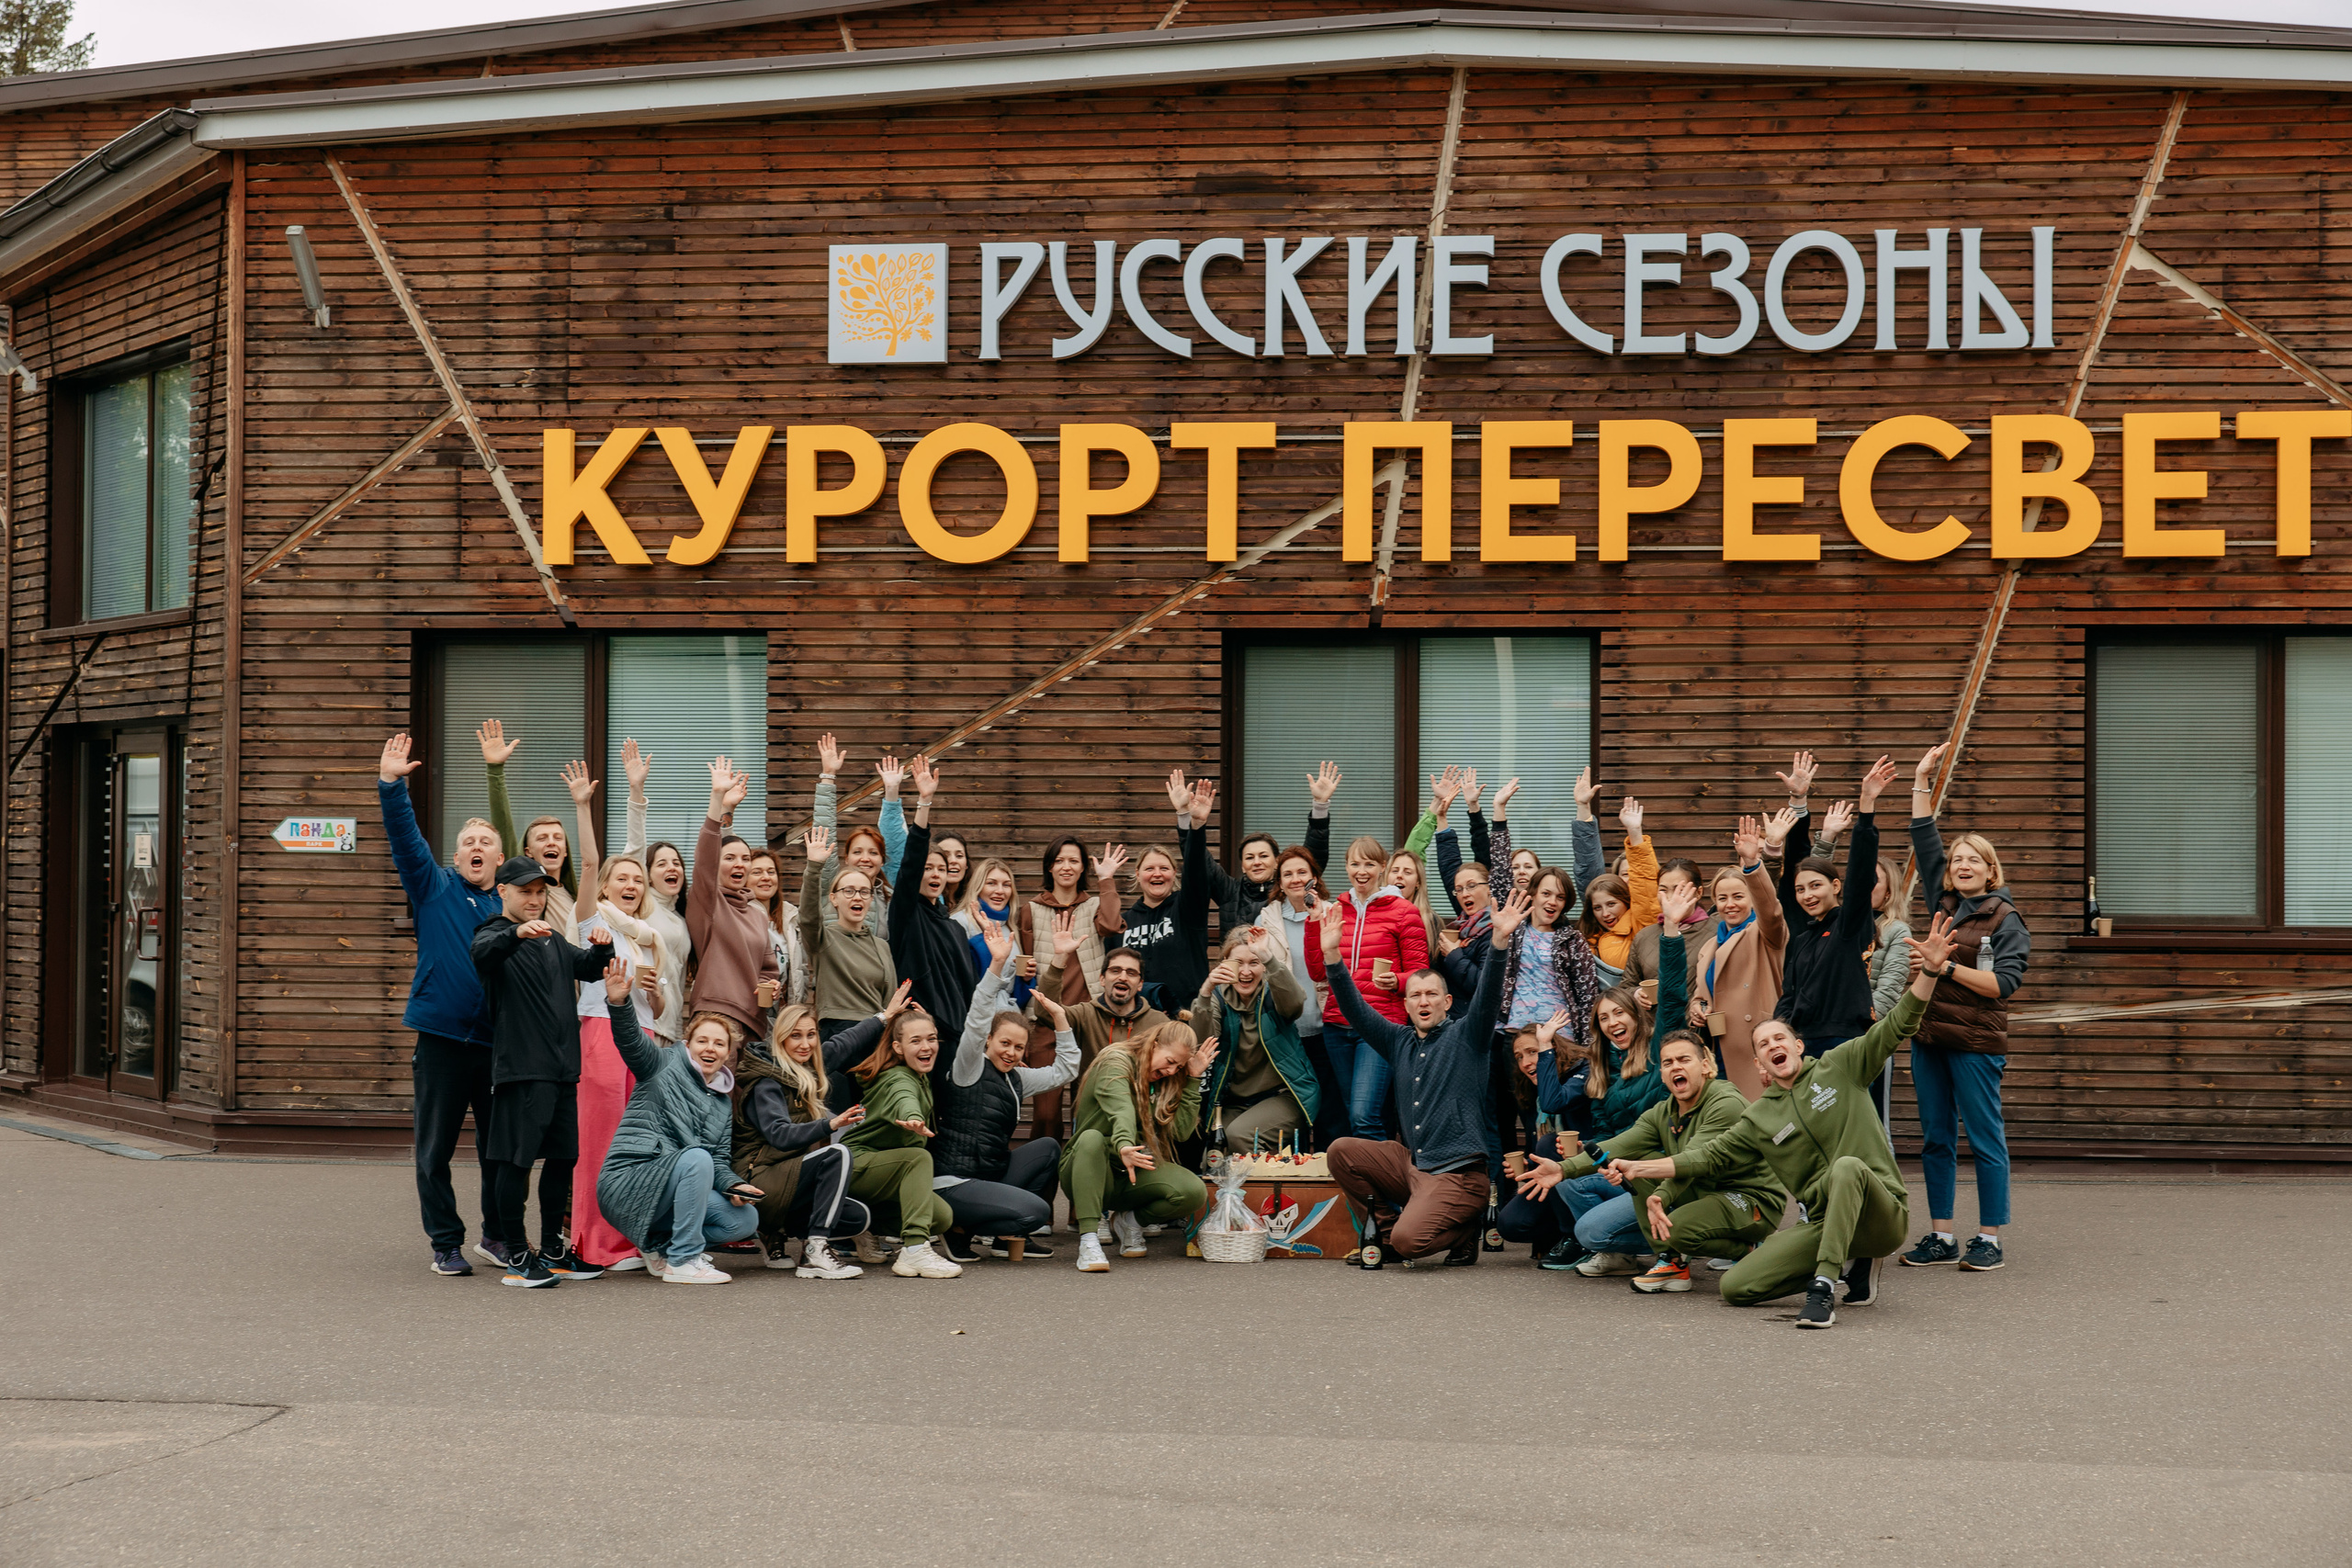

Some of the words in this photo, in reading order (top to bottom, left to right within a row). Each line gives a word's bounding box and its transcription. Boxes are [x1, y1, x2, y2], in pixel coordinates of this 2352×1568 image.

[978, 234, 1496, 363] РУССКИЕ
[1540, 226, 2056, 355] СЕЗОНЫ
[541, 421, 1277, 567] КУРОРТ
[1341, 410, 2352, 564] ПЕРЕСВЕТ
